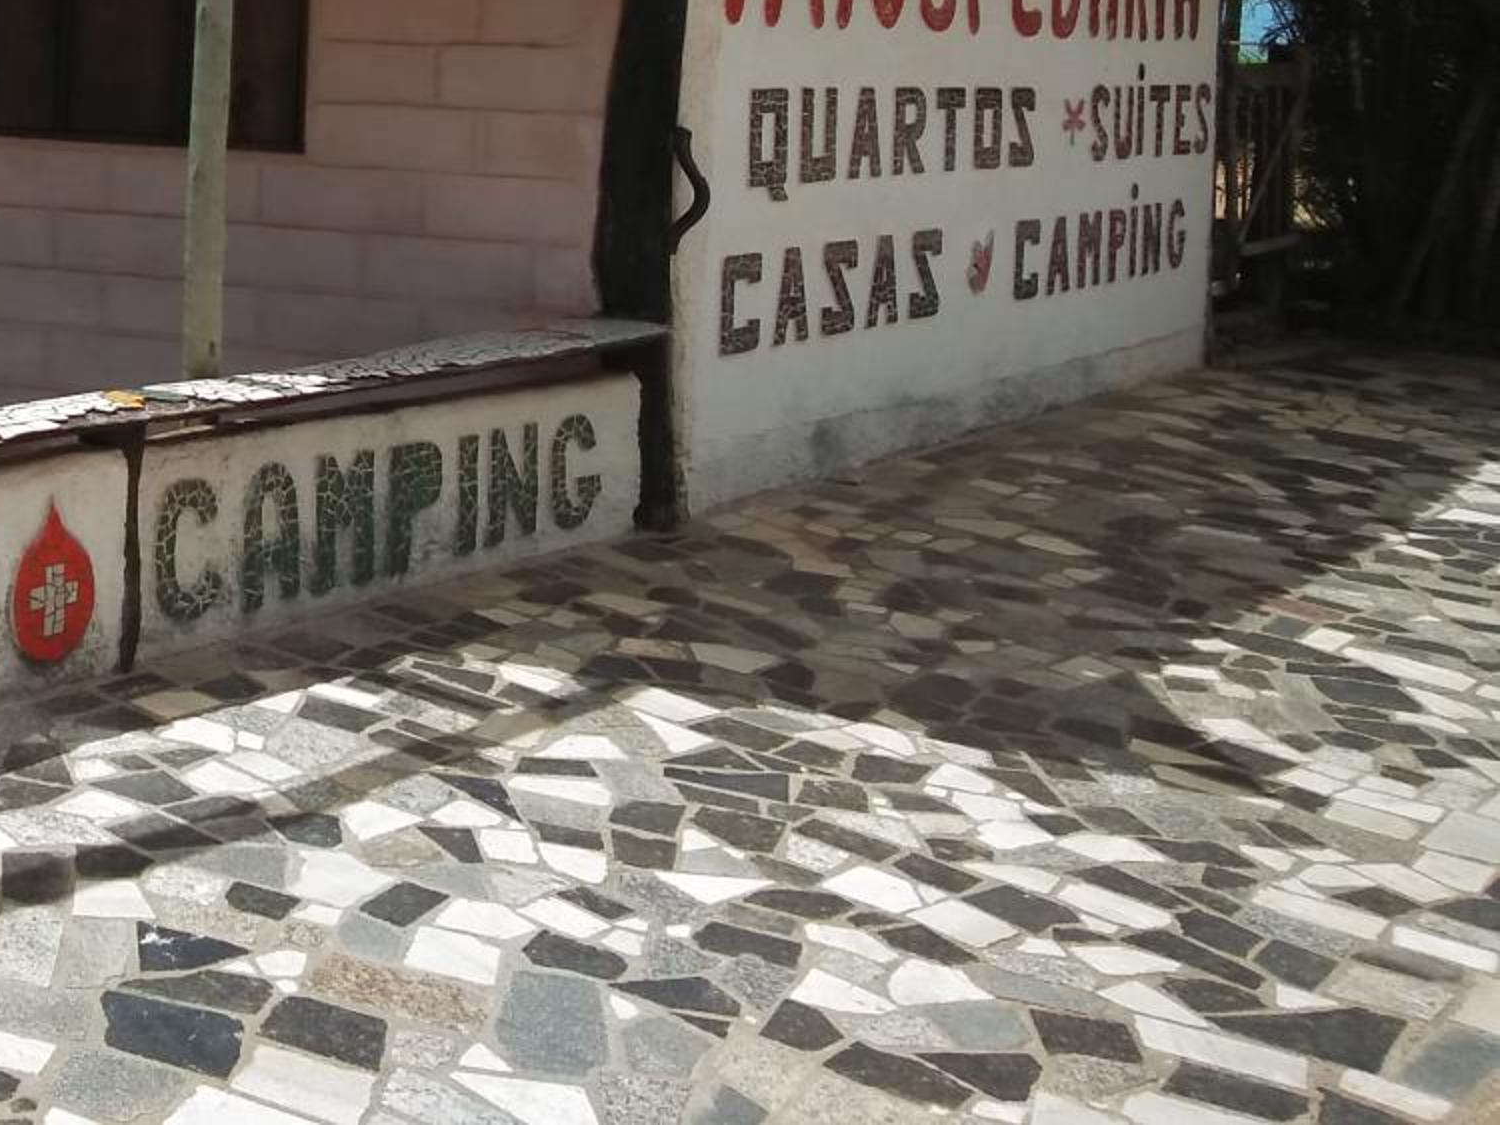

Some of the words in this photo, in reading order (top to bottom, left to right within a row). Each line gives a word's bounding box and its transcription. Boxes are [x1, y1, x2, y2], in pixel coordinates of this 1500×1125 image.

[747, 87, 1037, 202] QUARTOS
[718, 228, 944, 358] CASAS
[154, 413, 602, 622] CAMPING
